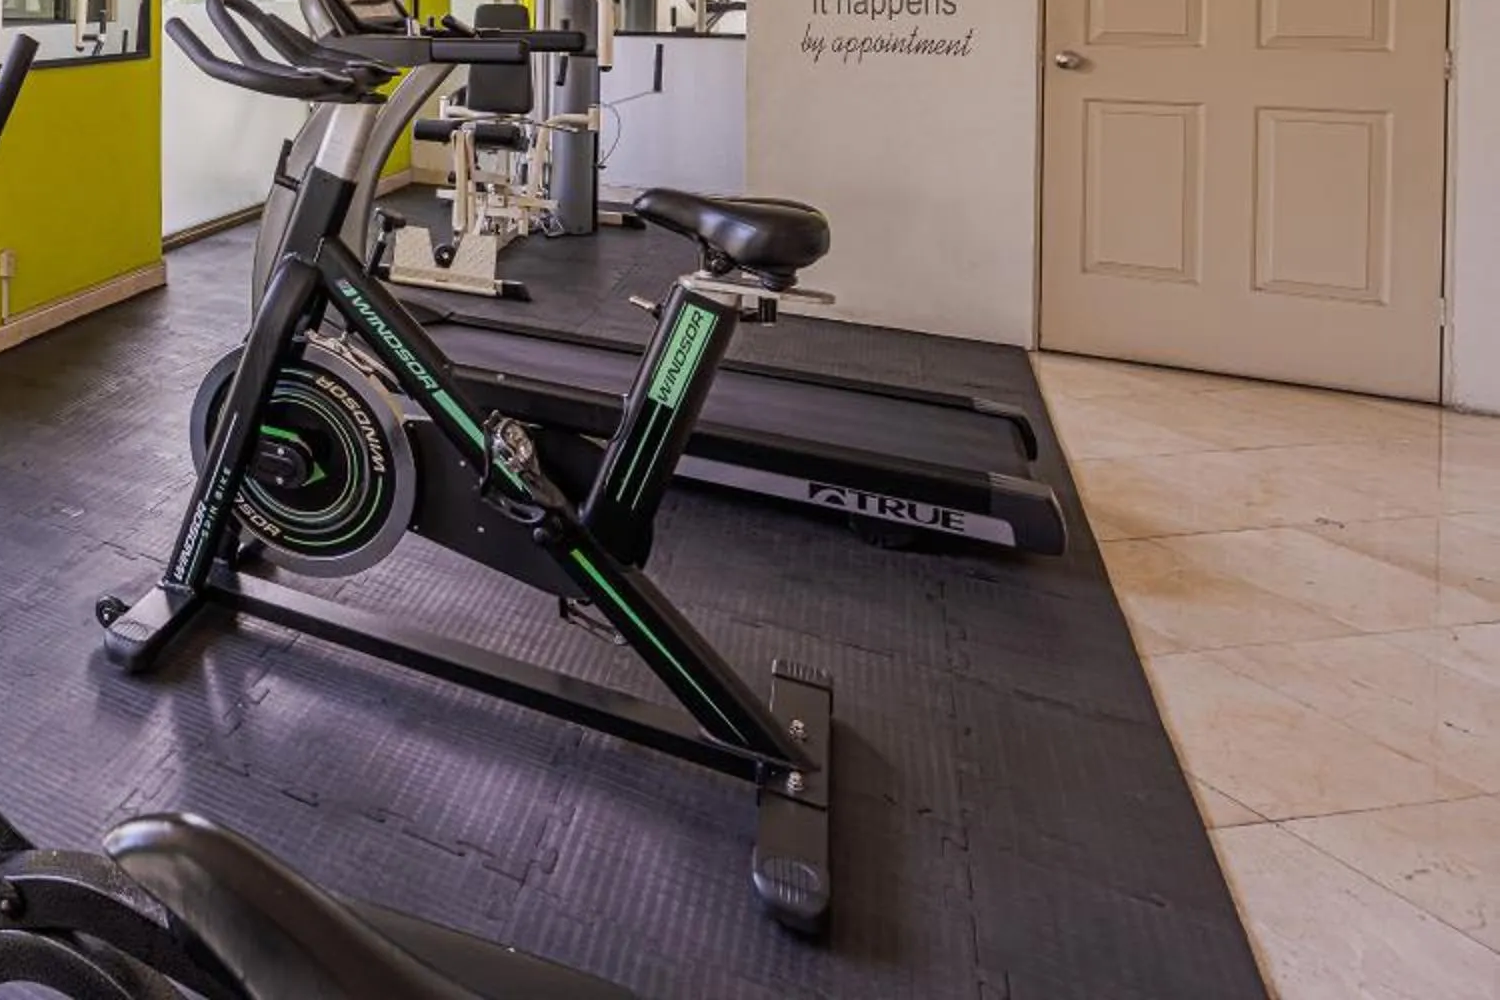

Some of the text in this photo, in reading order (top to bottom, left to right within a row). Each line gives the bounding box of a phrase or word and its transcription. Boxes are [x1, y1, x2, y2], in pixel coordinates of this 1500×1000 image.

[801, 22, 974, 64] by appointment
[352, 295, 440, 390] WINDSOR
[658, 309, 705, 404] WINDSOR
[315, 375, 387, 473] WINDSOR
[173, 499, 207, 581] WINDSOR
[847, 487, 966, 532] TRUE
